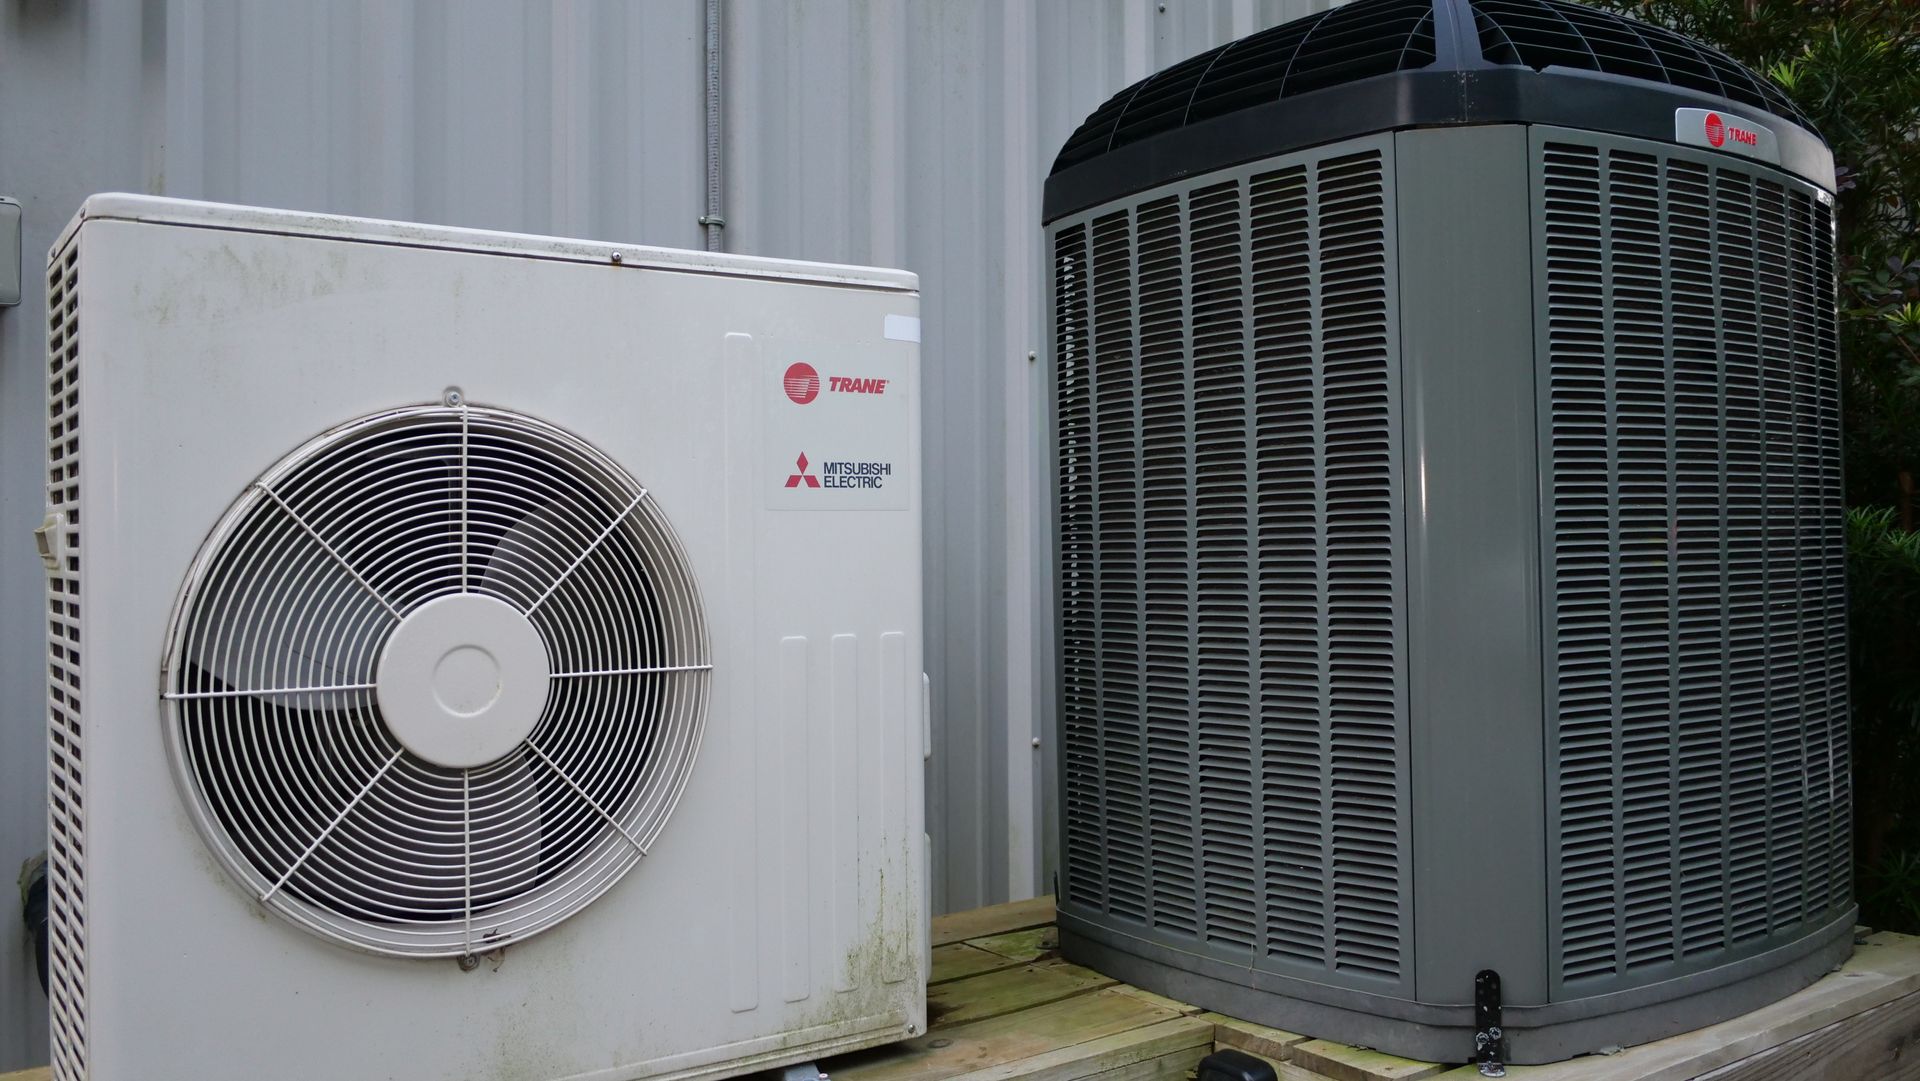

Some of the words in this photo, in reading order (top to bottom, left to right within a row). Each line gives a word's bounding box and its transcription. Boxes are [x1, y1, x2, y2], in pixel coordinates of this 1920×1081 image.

[1728, 127, 1757, 146] TRANE
[829, 376, 887, 394] TRANE
[823, 462, 891, 475] MITSUBISHI
[823, 476, 883, 489] ELECTRIC
